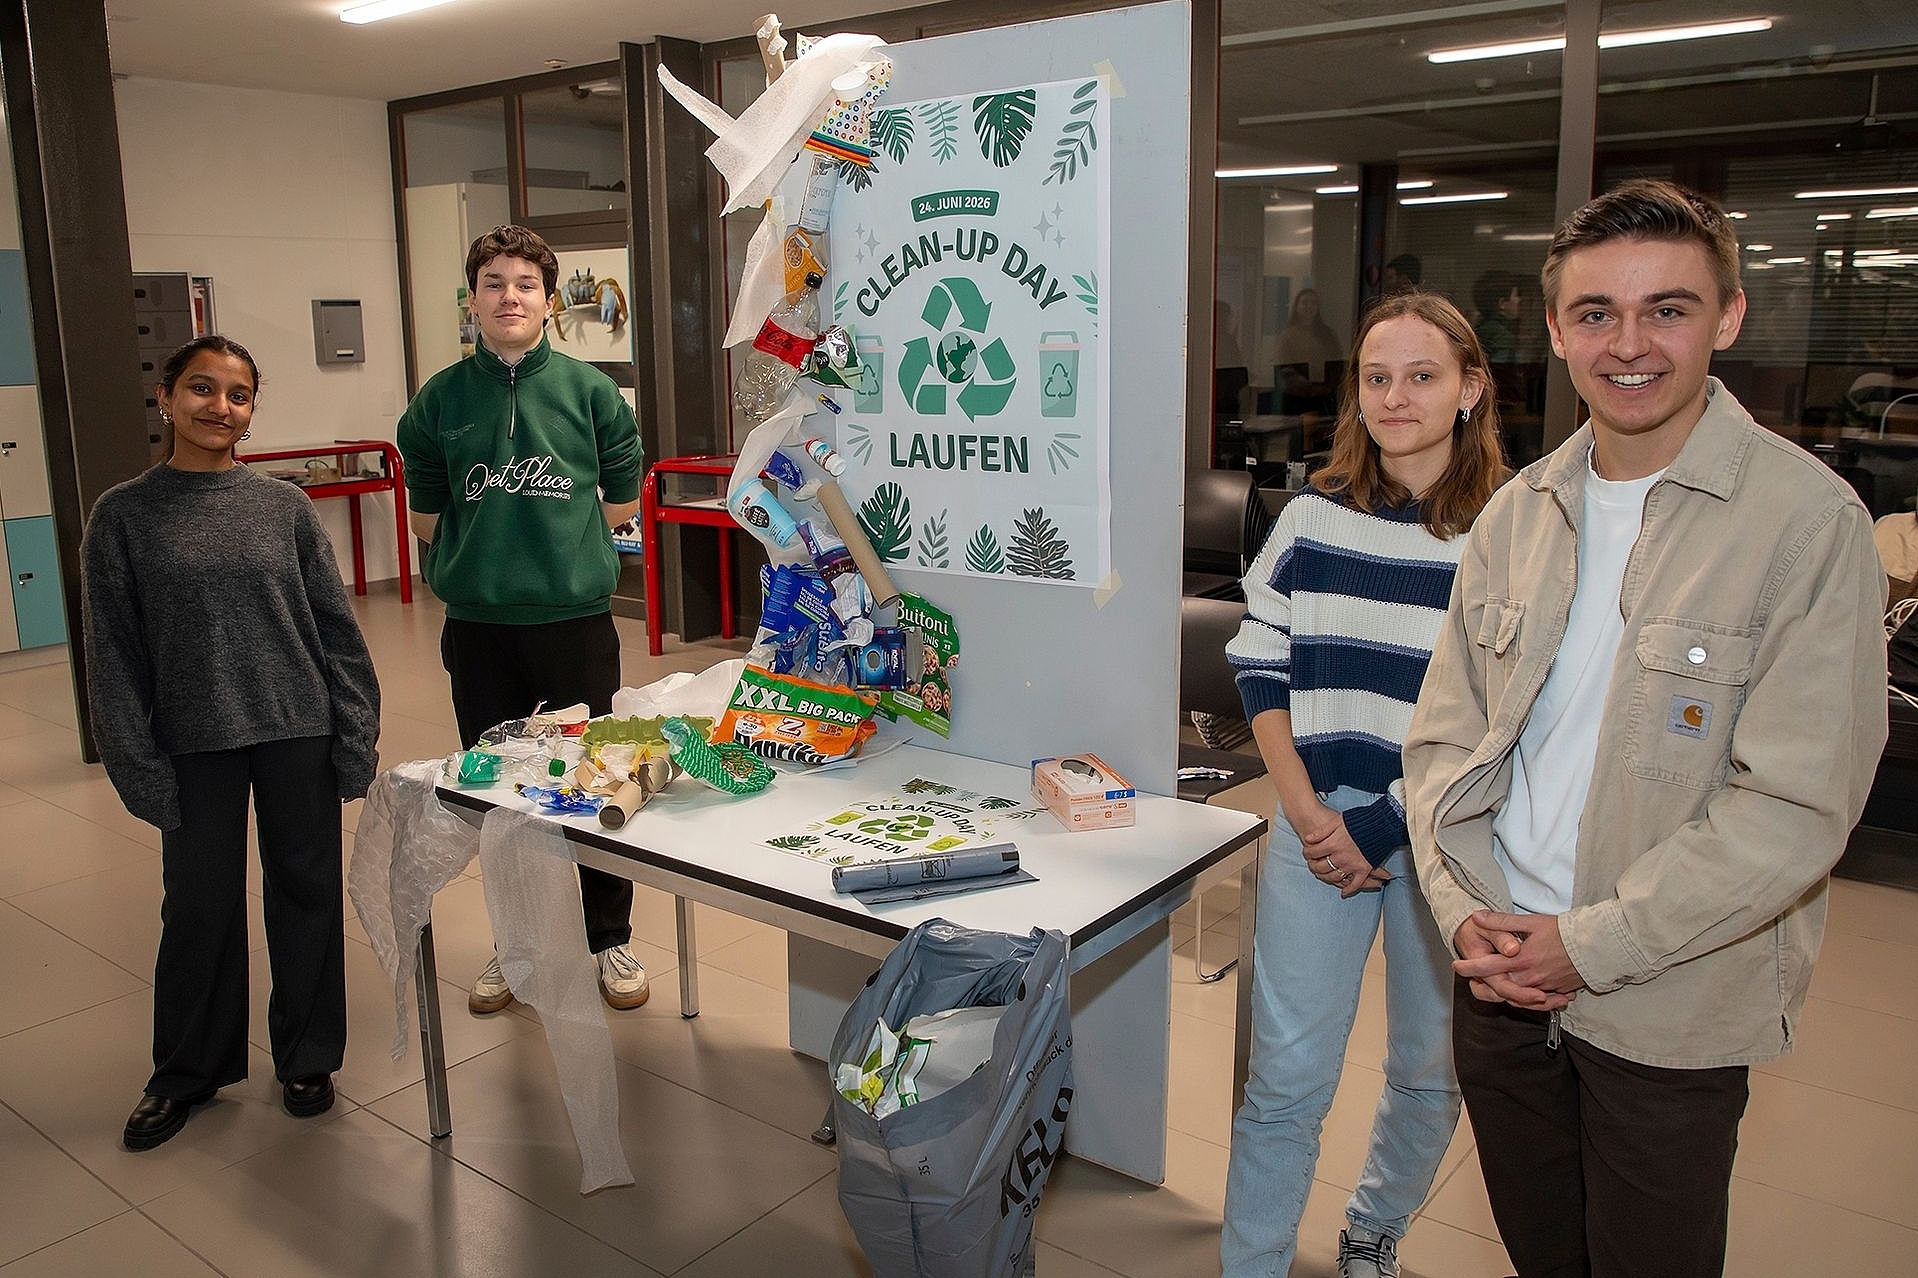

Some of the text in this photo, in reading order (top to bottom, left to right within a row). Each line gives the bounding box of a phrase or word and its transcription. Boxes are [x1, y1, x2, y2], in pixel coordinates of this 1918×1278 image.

[918, 196, 991, 215] 24. JUNI 2026
[856, 227, 1068, 317] CLEAN-UP DAY
[889, 432, 1029, 473] LAUFEN
[505, 455, 574, 494] Place
[897, 598, 949, 636] Buitoni
[734, 679, 862, 725] XXL BIG PACK
[865, 803, 958, 823] CLEAN-UP
[952, 816, 976, 835] DAY
[824, 829, 909, 855] LAUFEN
